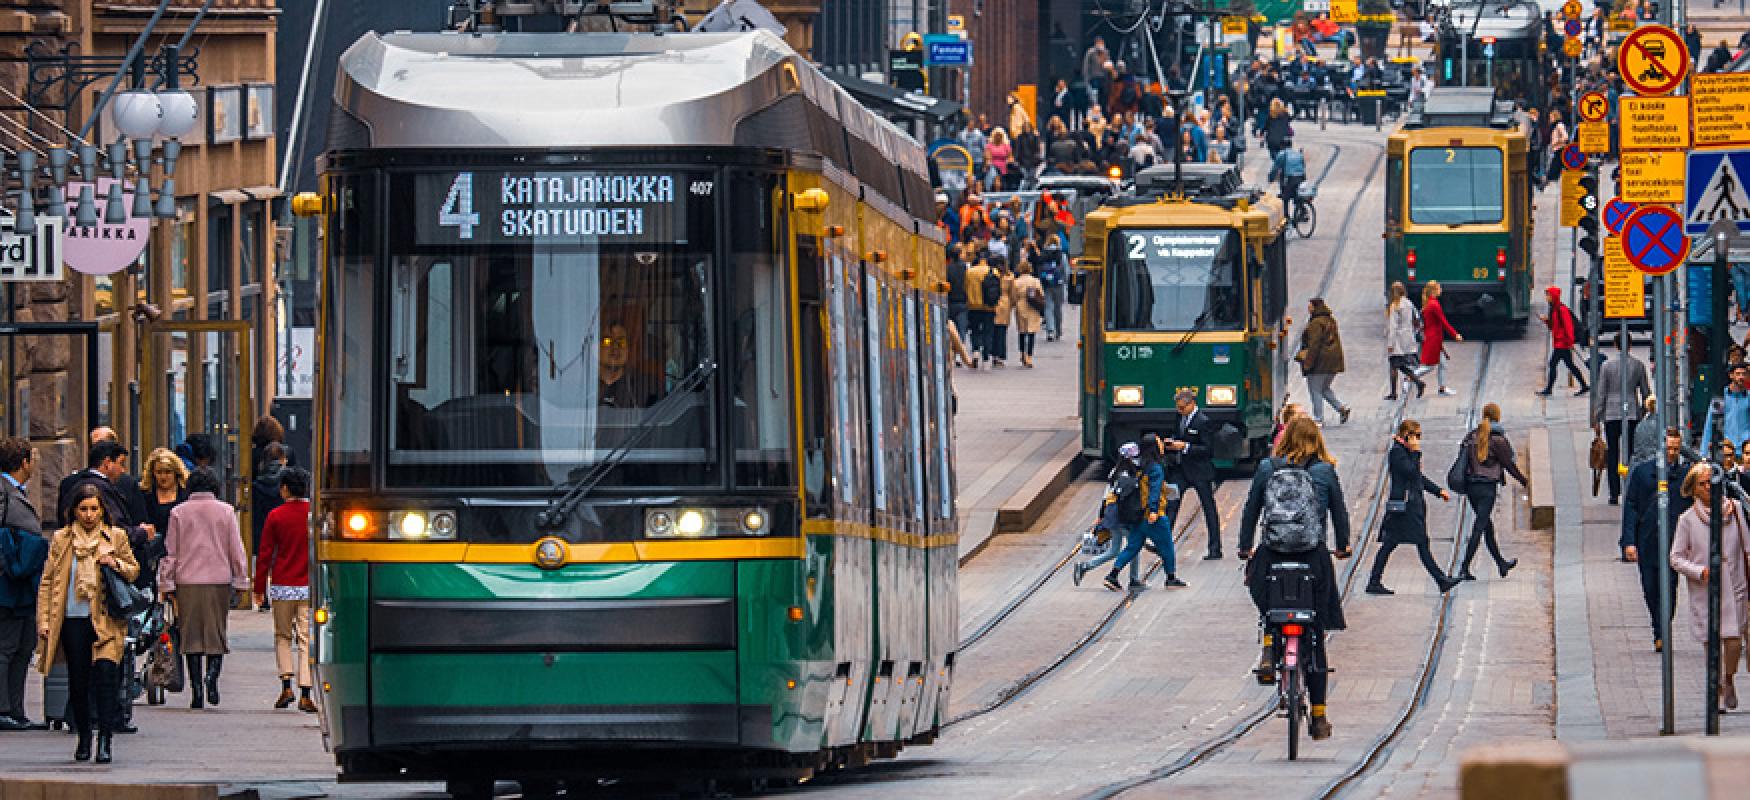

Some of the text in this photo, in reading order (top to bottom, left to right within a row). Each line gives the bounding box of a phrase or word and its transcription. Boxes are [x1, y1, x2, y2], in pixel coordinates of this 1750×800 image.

[1445, 149, 1456, 163] 2
[501, 175, 674, 204] KATAJANOKKA
[689, 181, 713, 195] 407
[439, 171, 481, 239] 4
[501, 208, 643, 236] SKATUDDEN
[1128, 234, 1146, 259] 2
[1473, 267, 1489, 279] 89
